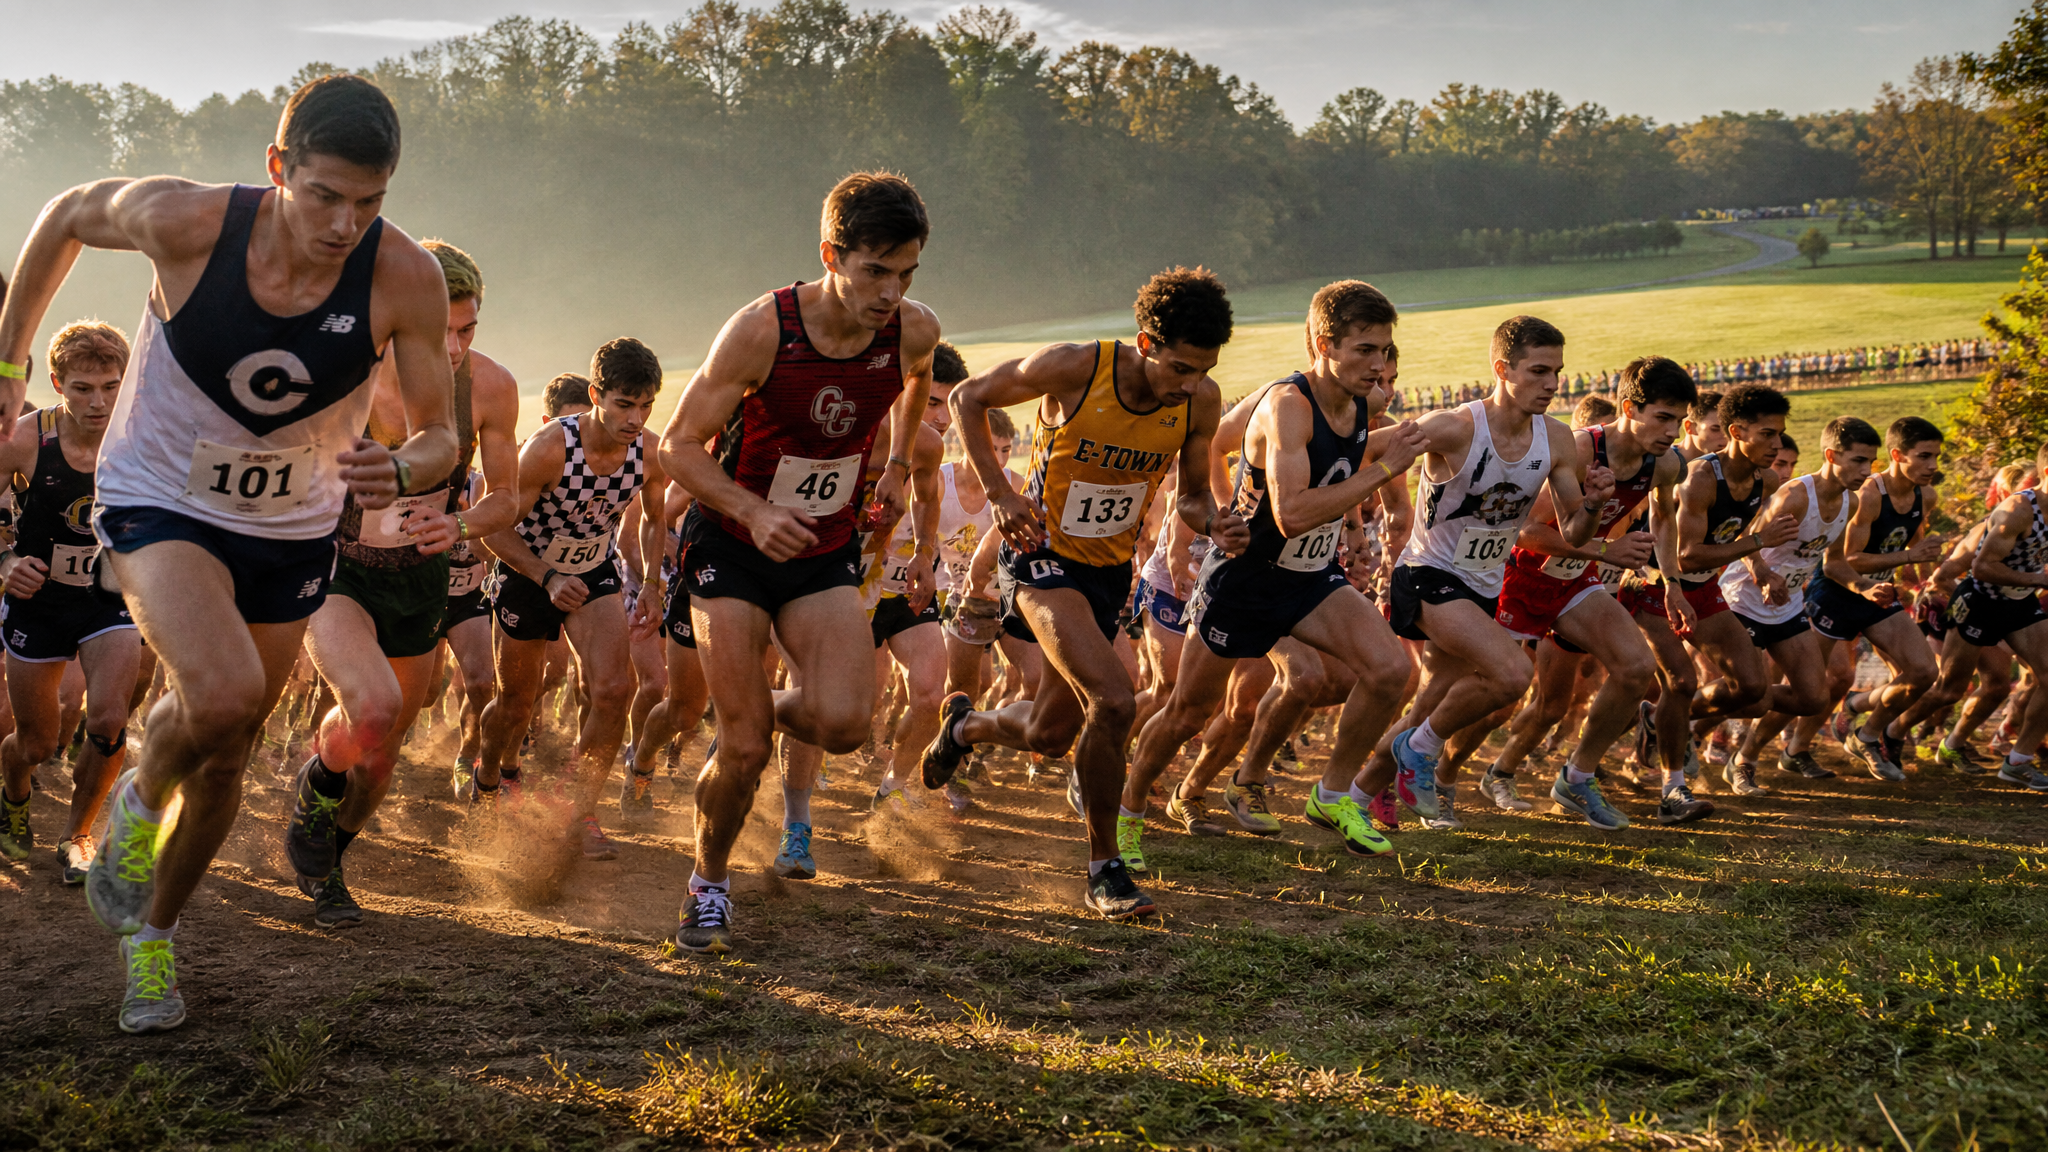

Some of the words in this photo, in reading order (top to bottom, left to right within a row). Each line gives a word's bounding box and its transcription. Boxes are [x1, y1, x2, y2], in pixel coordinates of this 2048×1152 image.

[1073, 438, 1169, 473] E-TOWN
[209, 462, 293, 499] 101
[795, 472, 840, 500] 46
[1077, 497, 1133, 523] 133
[555, 544, 600, 564] 150
[1293, 533, 1334, 559] 103
